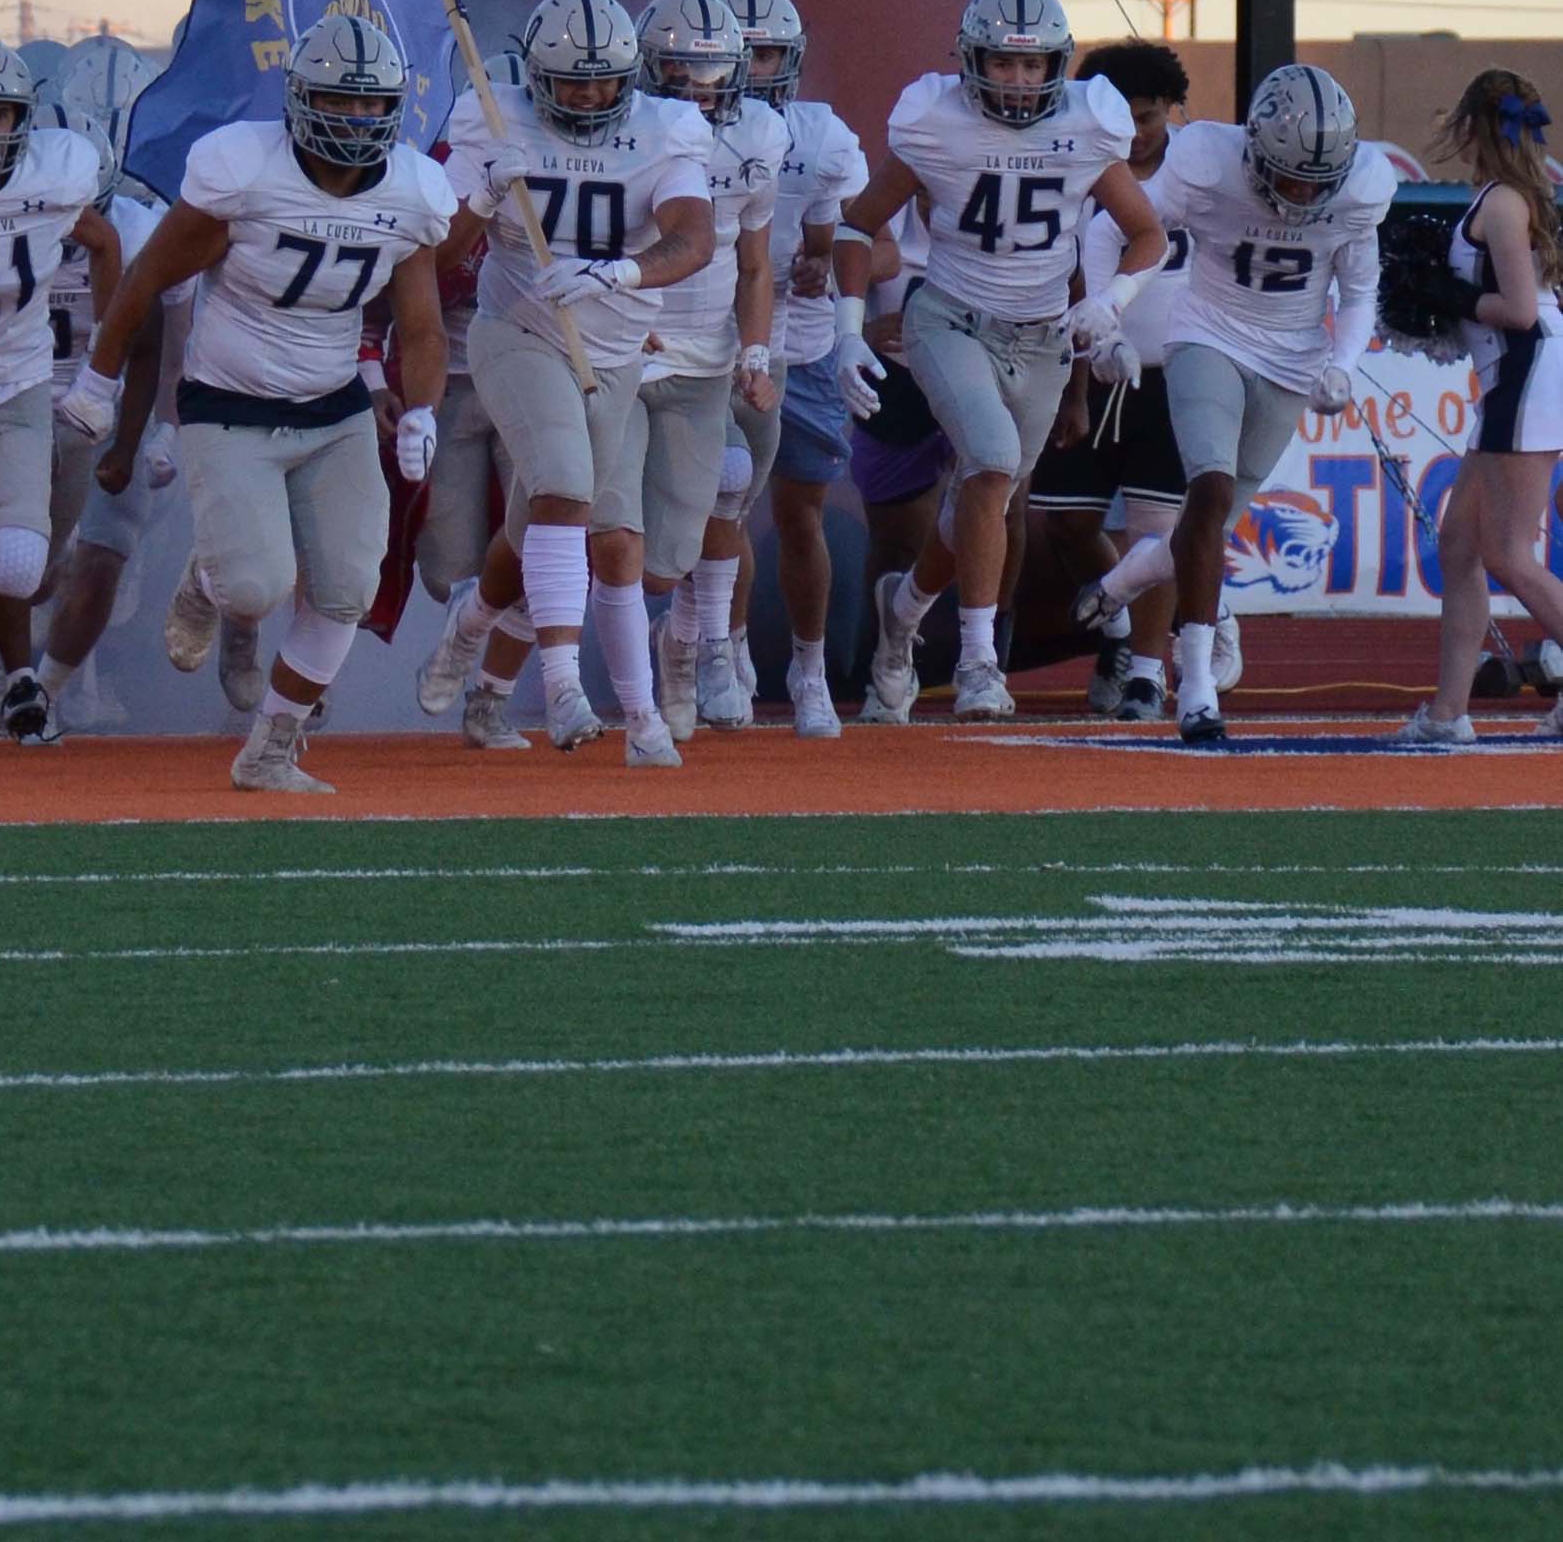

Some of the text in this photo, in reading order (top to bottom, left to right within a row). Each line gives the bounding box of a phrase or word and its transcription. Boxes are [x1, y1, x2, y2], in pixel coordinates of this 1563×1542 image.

[542, 154, 606, 174] LA CUEVA
[986, 156, 1044, 170] LA CUEVA
[303, 219, 364, 242] LA CUEVA
[524, 176, 625, 260] 70
[959, 172, 1064, 253] 45
[1245, 226, 1303, 242] LA CUEVA
[273, 232, 381, 313] 77
[1233, 240, 1313, 292] 12
[1297, 390, 1416, 444] ome
